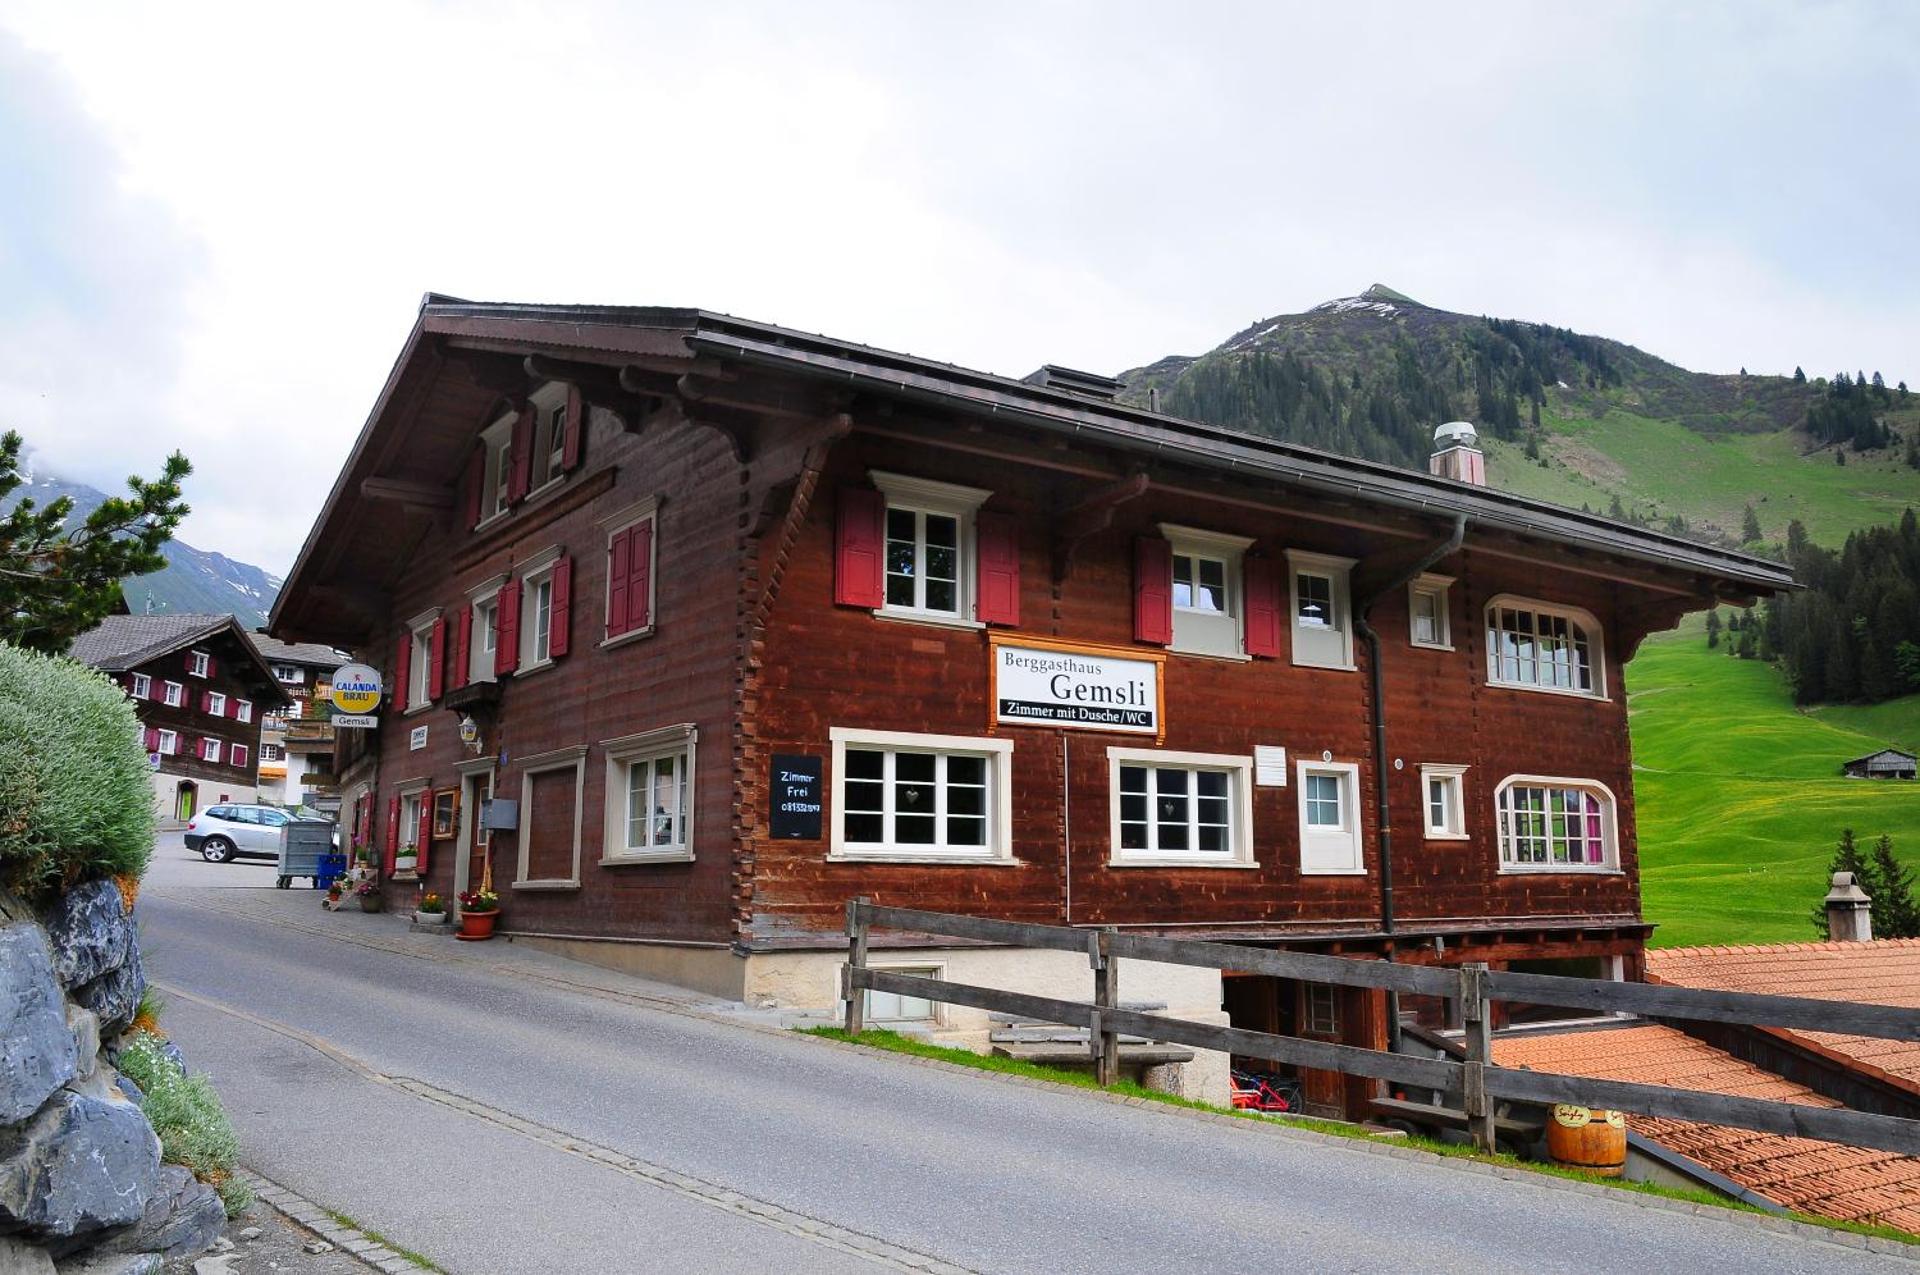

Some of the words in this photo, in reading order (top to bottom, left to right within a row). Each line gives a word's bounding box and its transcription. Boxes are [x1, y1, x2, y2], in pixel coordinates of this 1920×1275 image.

[1004, 652, 1102, 675] Berggasthaus
[336, 682, 377, 691] CALANDA
[1050, 674, 1146, 706] Gemsli
[1007, 702, 1054, 717] Zimmer
[1056, 707, 1076, 719] mit
[1079, 708, 1147, 724] Dusche/WC
[780, 771, 815, 782] Zimmer
[787, 786, 808, 797] Frei
